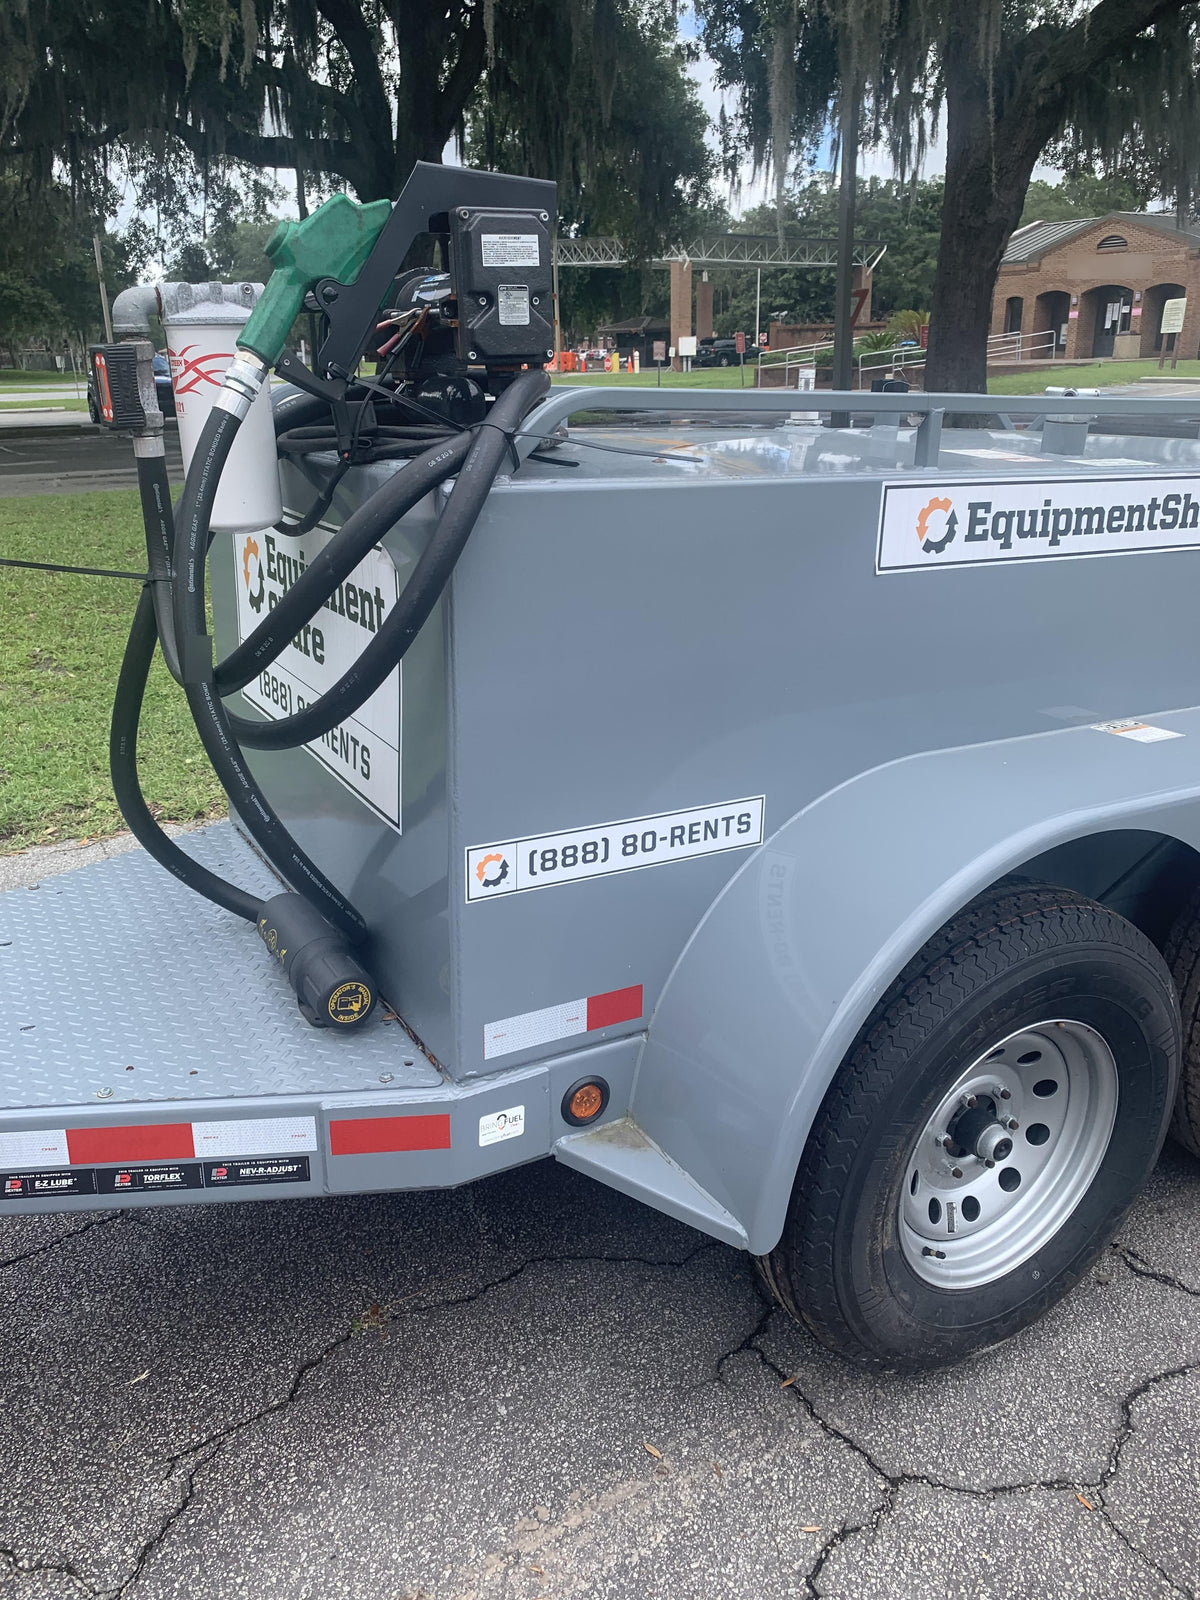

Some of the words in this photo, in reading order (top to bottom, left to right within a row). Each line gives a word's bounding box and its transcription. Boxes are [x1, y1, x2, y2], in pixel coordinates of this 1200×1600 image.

[202, 457, 212, 476] STATIC
[529, 837, 610, 876] (888)
[622, 812, 751, 857] 80-RENTS
[330, 984, 356, 1010] OPERATOR'S
[338, 1012, 359, 1021] INSIDE
[240, 1165, 298, 1174] NEV-R-ADJUST
[143, 1172, 180, 1181] TORFLEX
[50, 1178, 74, 1186] LUBE
